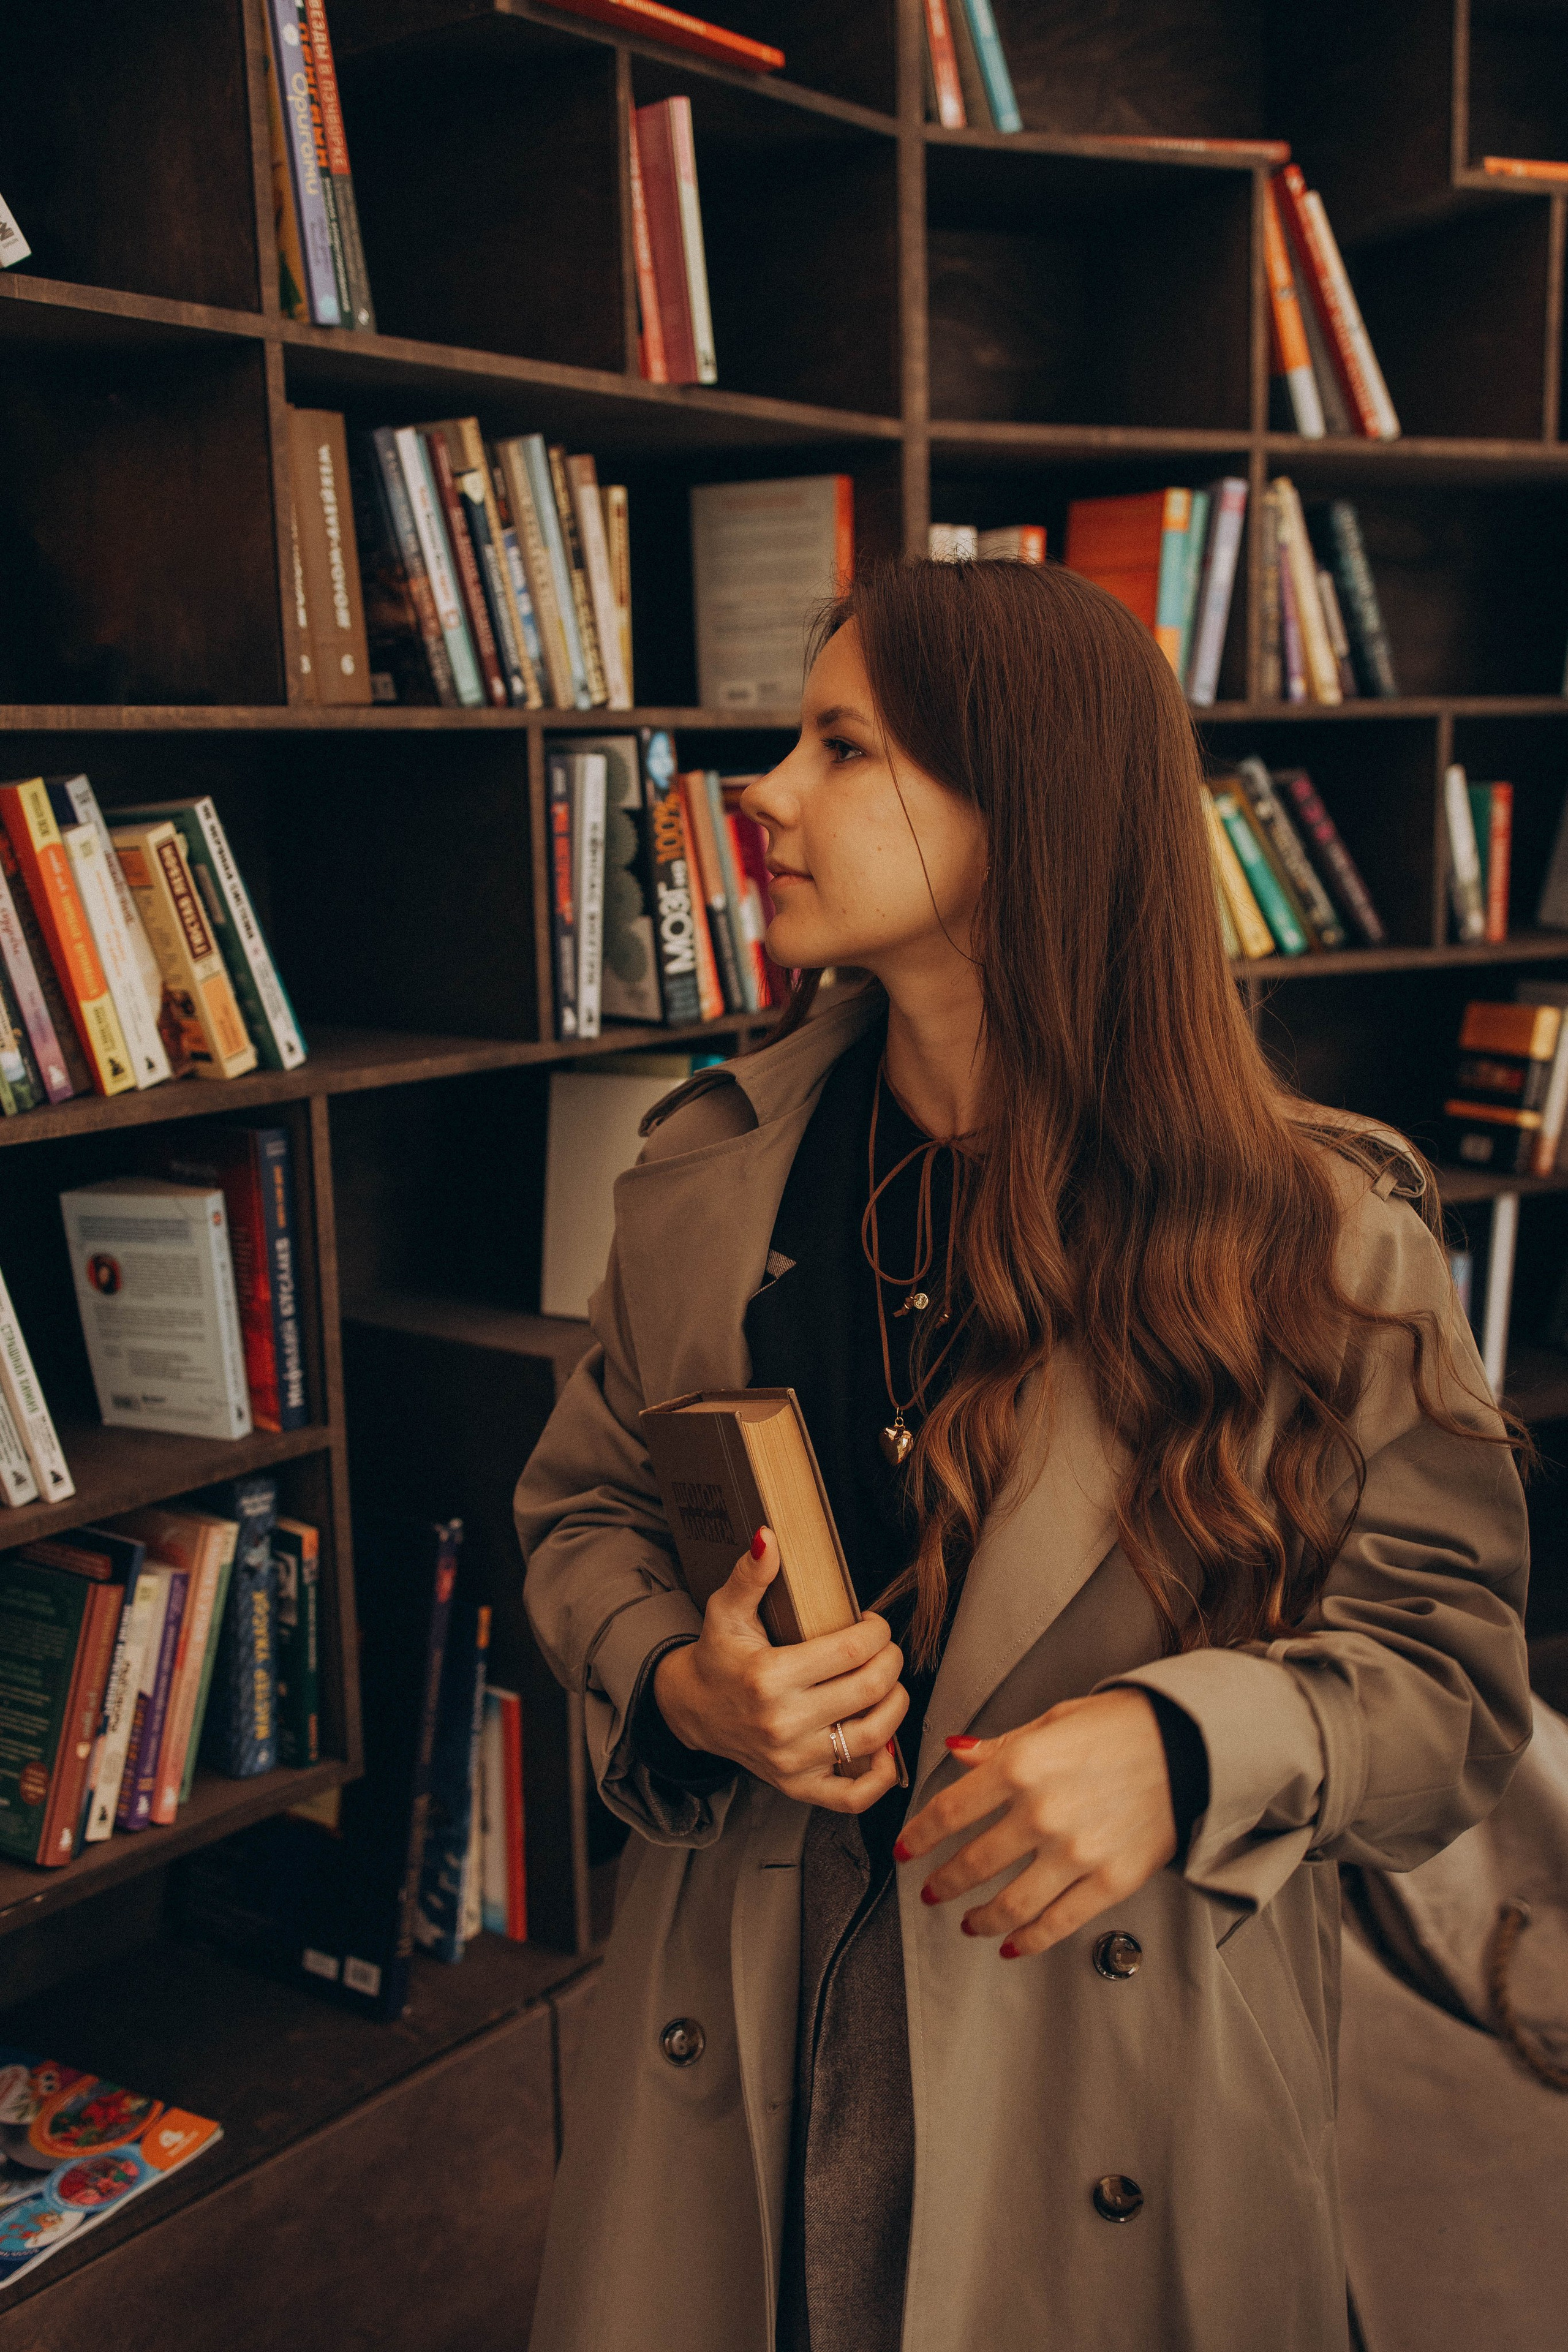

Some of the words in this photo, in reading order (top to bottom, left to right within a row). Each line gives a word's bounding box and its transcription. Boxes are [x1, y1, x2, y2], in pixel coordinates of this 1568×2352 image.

[318, 64, 333, 75] В
[286, 72, 319, 195] Оригами
[321, 80, 347, 166] ПЭЧВОРКЕ
[318, 444, 352, 630] ШОЛОМ-АЛЕЙХЕМ
[654, 794, 685, 865] 100%
[657, 881, 695, 974] МОЗГ
